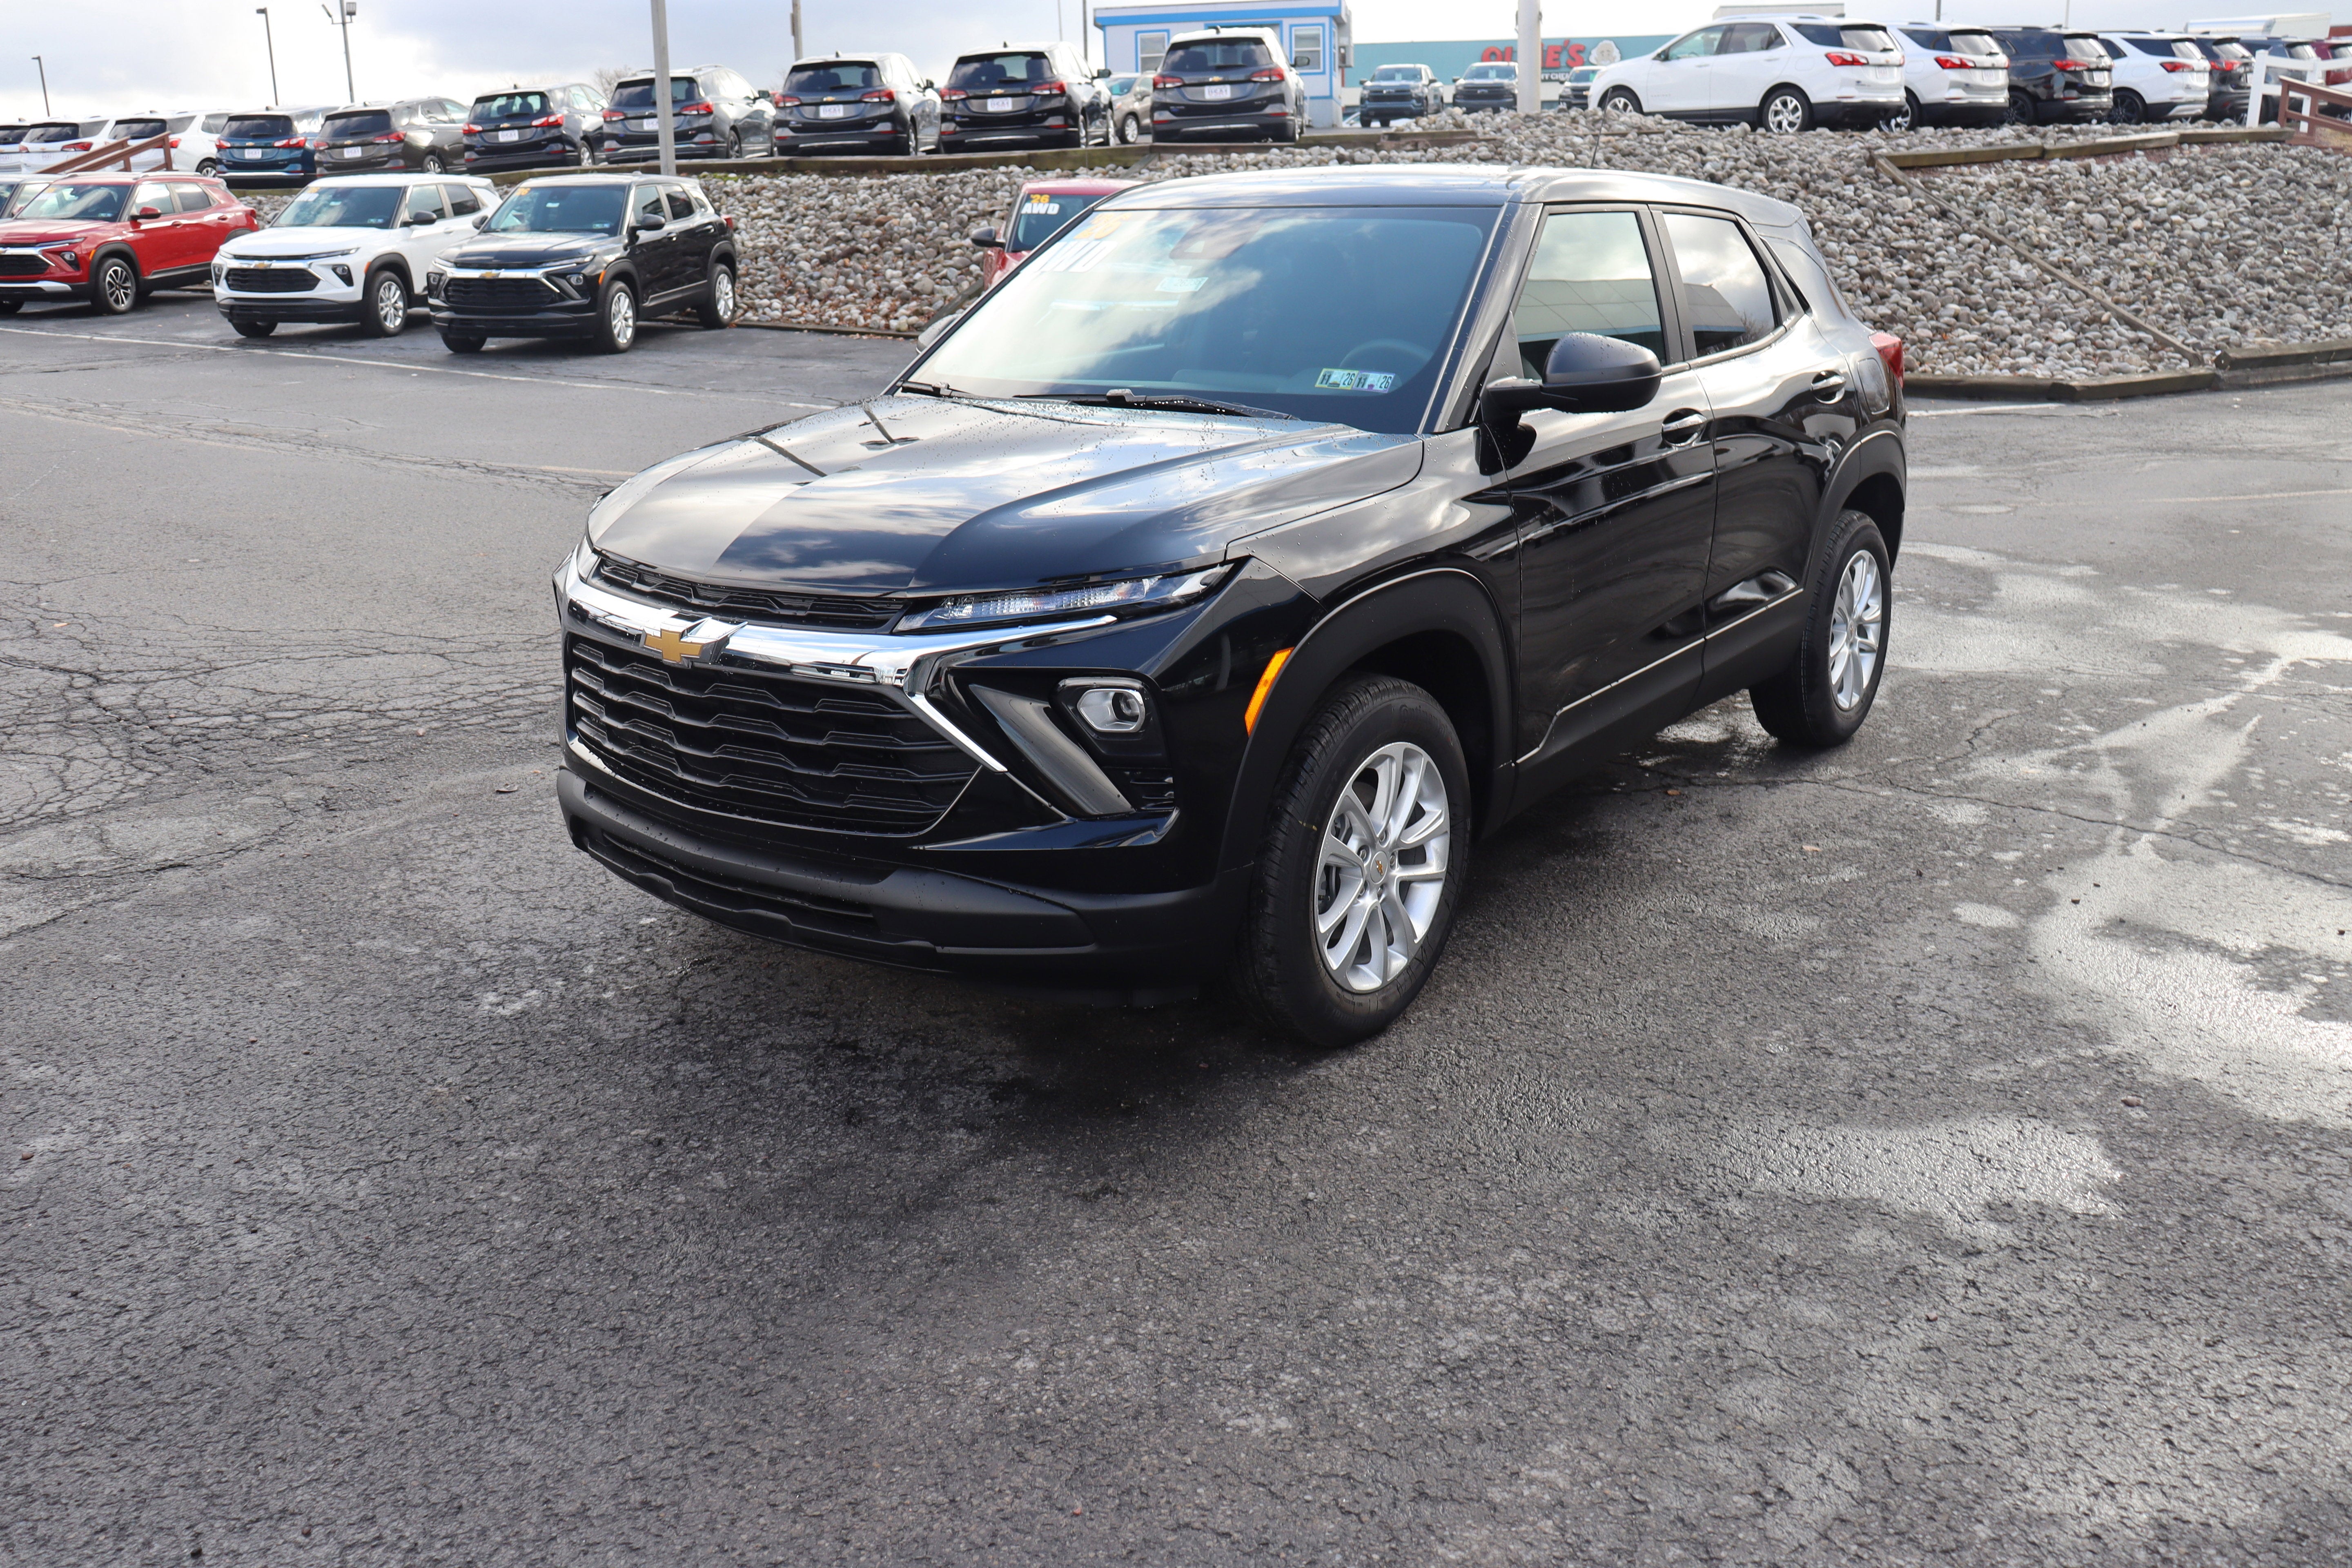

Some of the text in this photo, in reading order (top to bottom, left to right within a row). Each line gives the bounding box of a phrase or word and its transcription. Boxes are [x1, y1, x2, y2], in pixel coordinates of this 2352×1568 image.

[1481, 39, 1586, 68] OLE'S
[1030, 194, 1050, 203] '26
[1021, 202, 1060, 215] AWD
[1343, 373, 1355, 386] 26
[1379, 375, 1392, 389] 26
